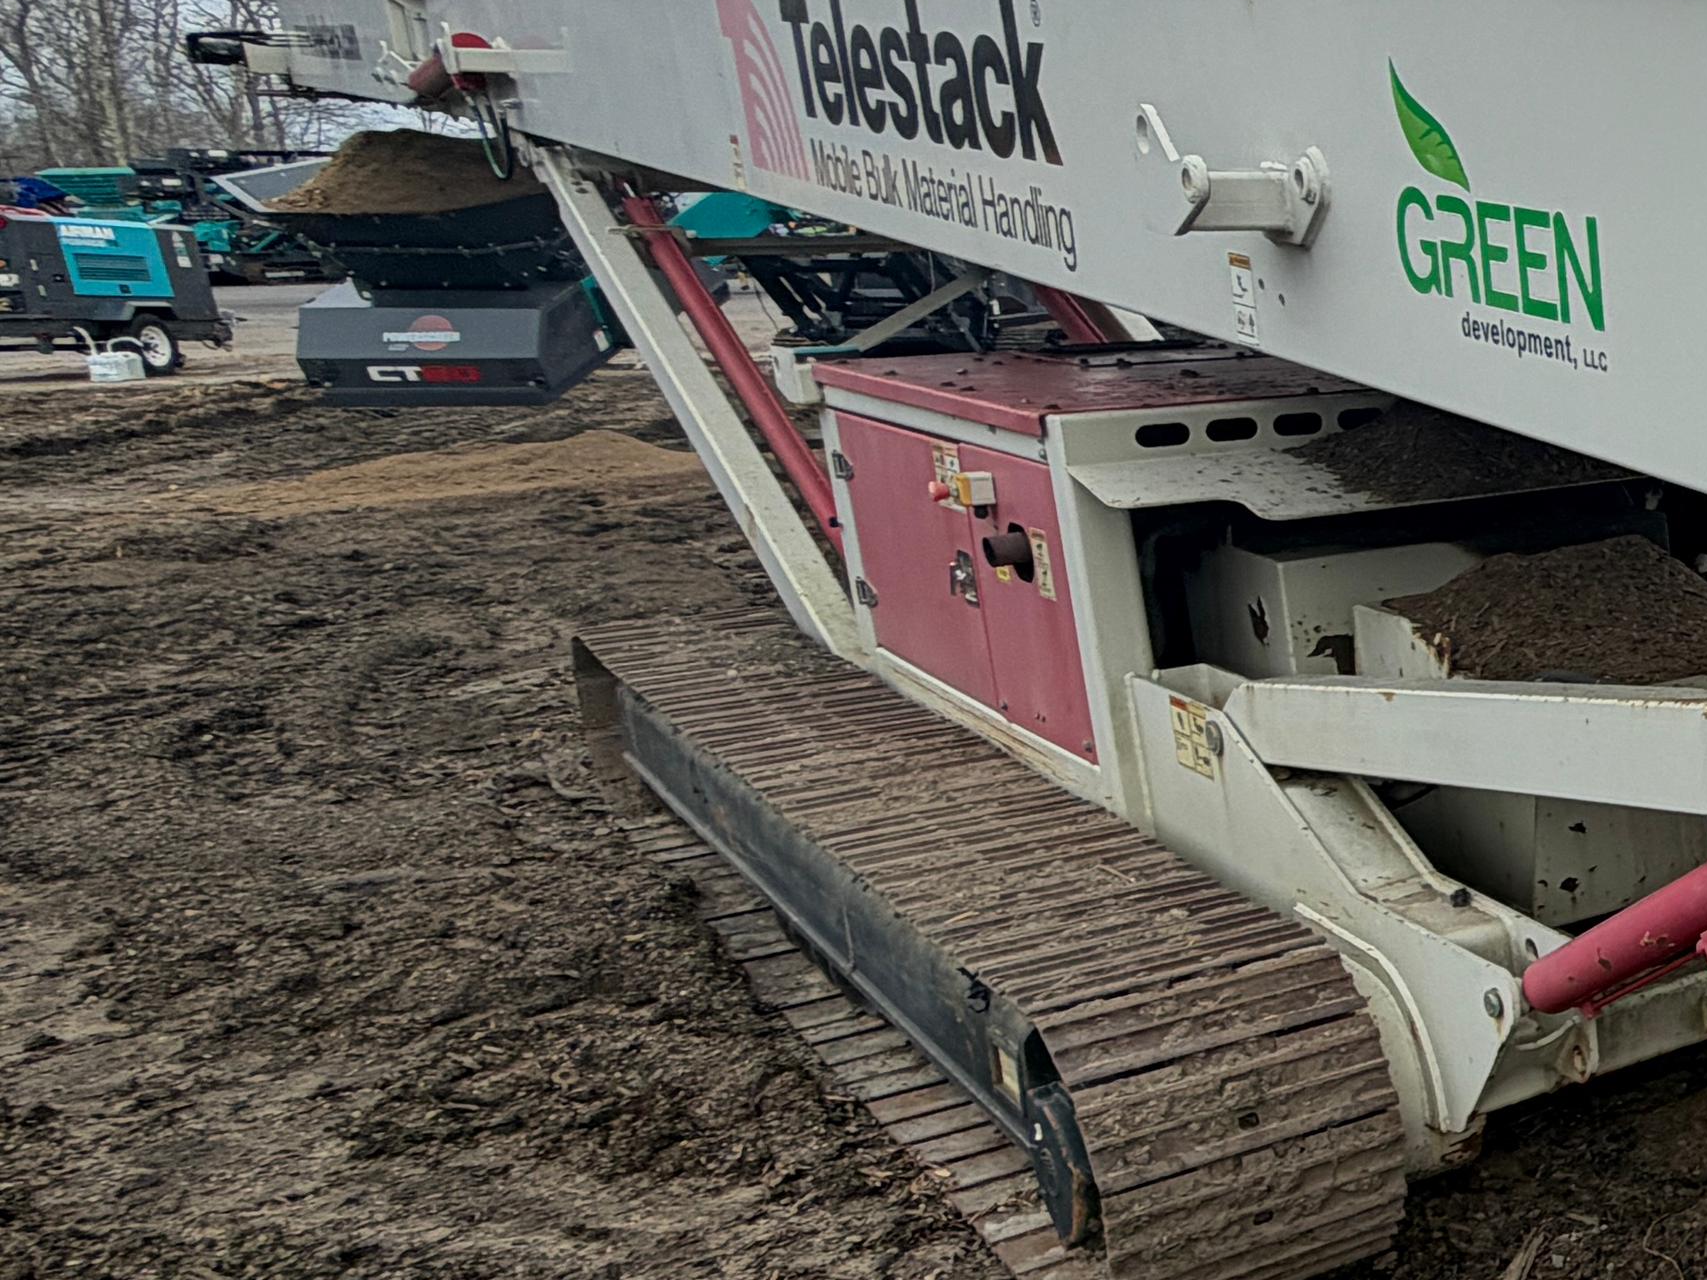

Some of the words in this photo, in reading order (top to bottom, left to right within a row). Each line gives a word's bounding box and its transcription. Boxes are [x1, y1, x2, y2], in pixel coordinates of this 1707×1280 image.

[810, 138, 862, 197] Mobile
[861, 149, 903, 208] Bulk
[902, 158, 978, 228] Material
[978, 175, 1077, 272] Handling
[1397, 186, 1605, 332] GREEN
[1461, 312, 1578, 370] development,
[1583, 348, 1607, 372] LLC
